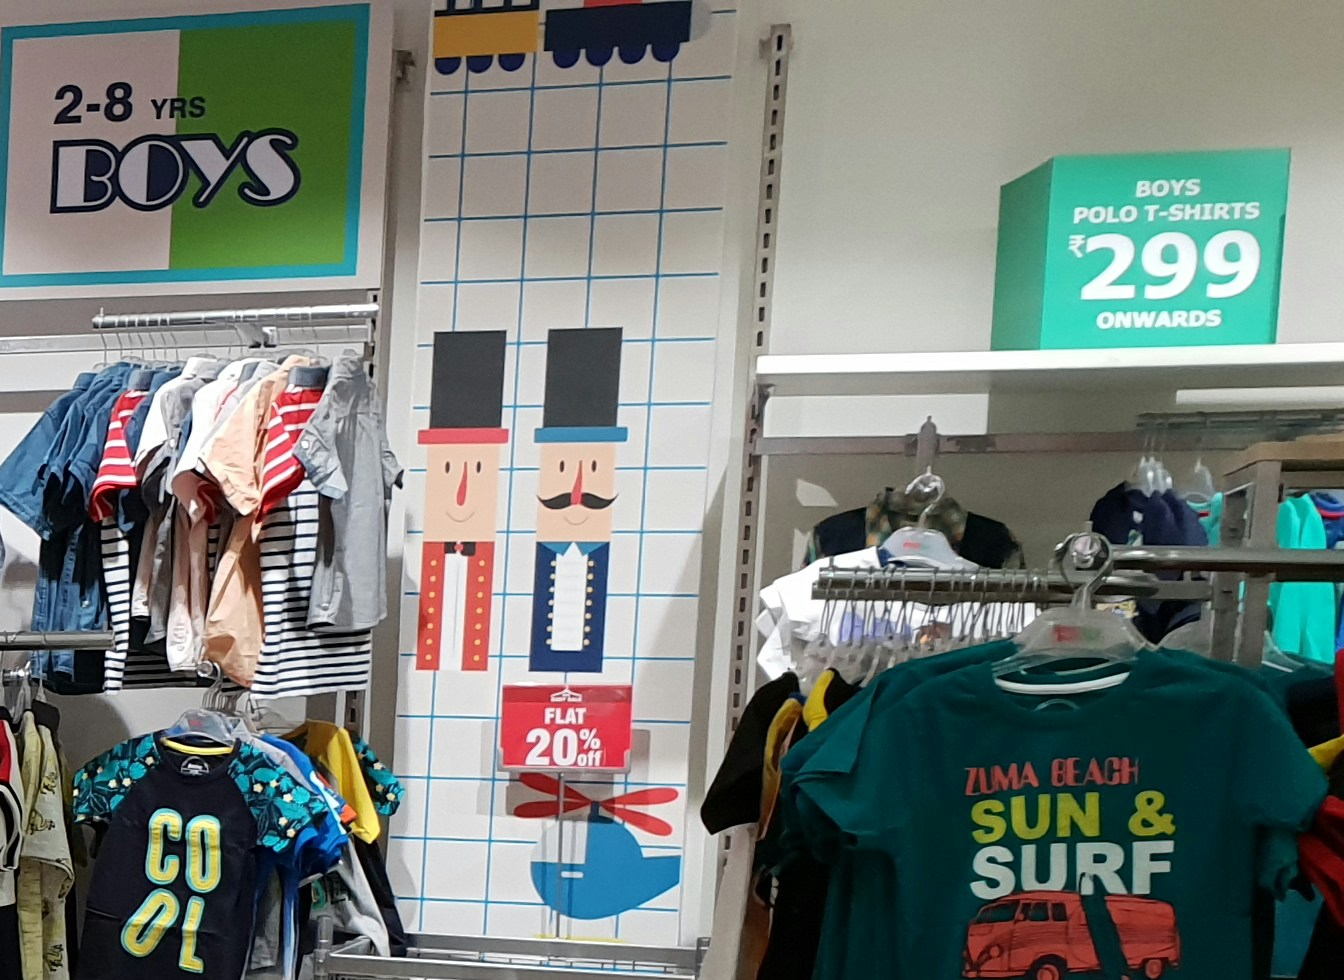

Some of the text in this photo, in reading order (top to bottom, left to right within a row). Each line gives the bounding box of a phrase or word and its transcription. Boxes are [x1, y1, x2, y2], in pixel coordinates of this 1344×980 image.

[54, 82, 206, 124] 2-8 YRS
[50, 128, 301, 214] BOYS
[1136, 179, 1201, 197] BOYS
[1073, 202, 1260, 224] POLO T-SHIRTS
[1096, 309, 1222, 329] ONWARDS
[544, 707, 587, 725] FLAT
[525, 728, 603, 767] 20% off
[965, 757, 1139, 795] ZUMA BEACH
[970, 790, 1175, 844] SUN &
[145, 808, 221, 893] CO
[970, 840, 1175, 900] SURF
[120, 888, 206, 974] OL
